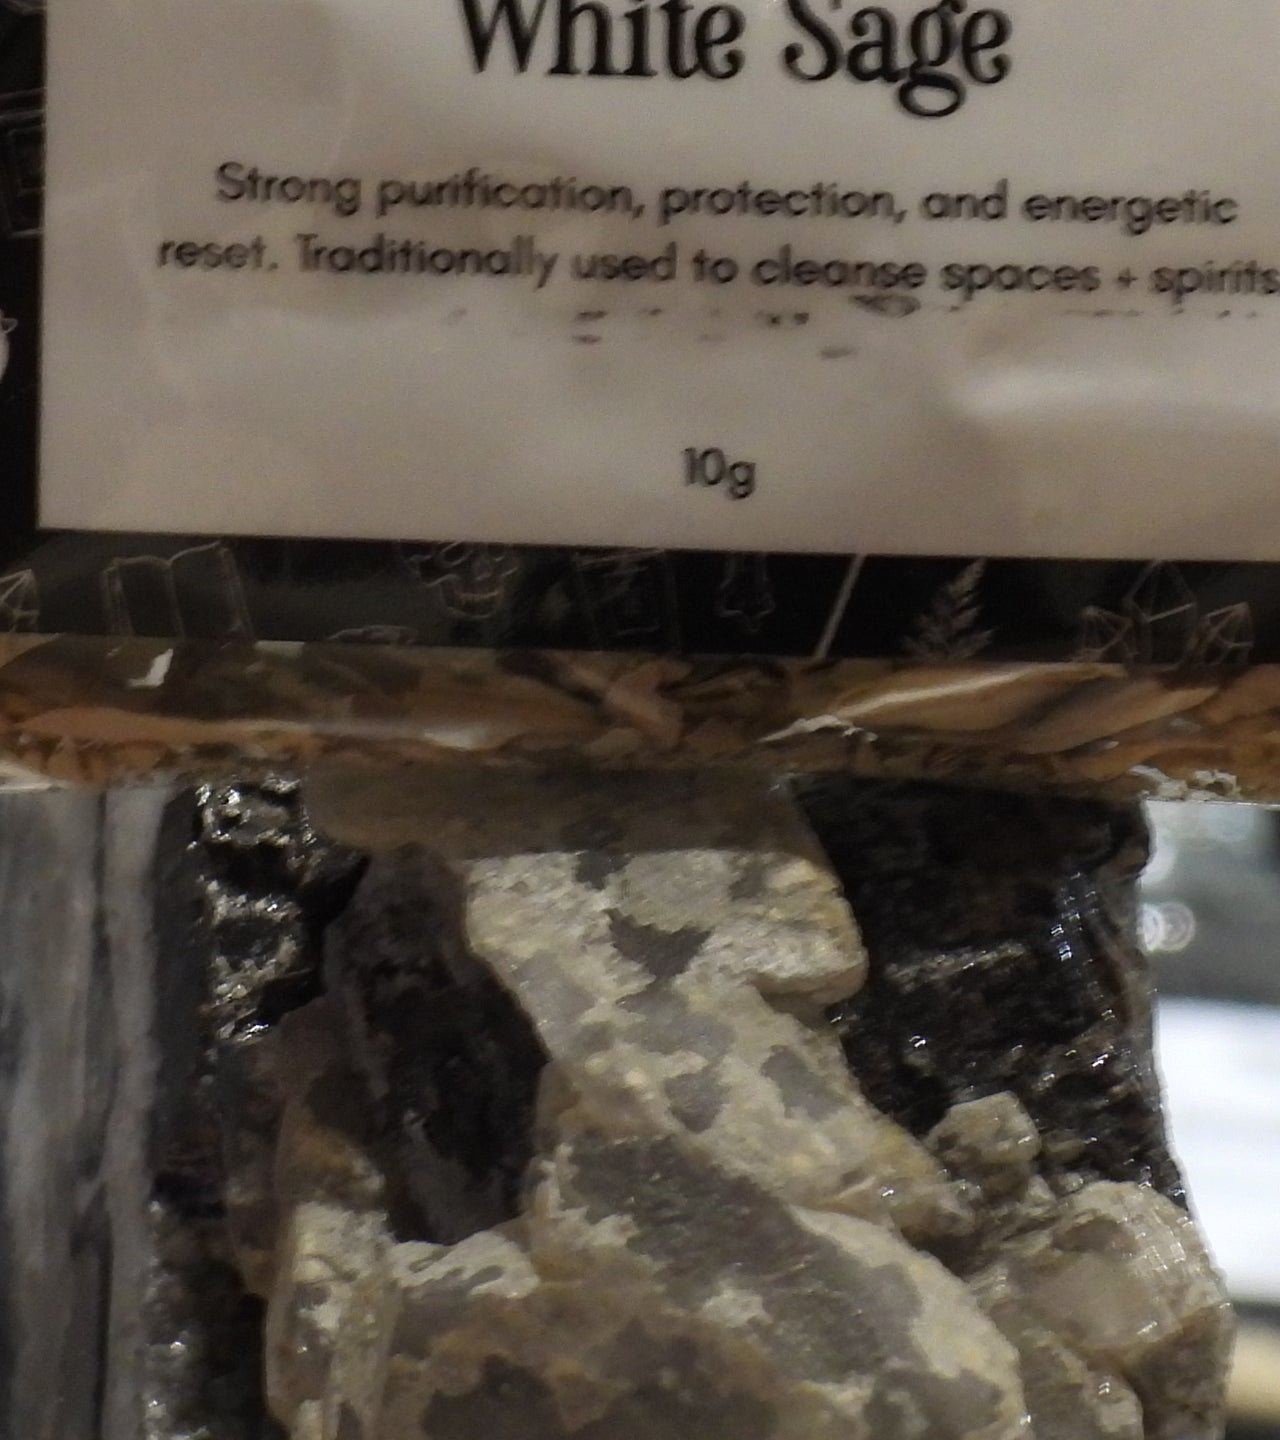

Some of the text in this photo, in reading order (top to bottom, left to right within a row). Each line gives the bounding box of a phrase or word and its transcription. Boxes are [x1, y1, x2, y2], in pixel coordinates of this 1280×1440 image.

[215, 160, 1240, 236] Strong purification, protection, and energetic
[156, 233, 280, 273] reset.
[293, 231, 560, 289] Traditionally
[570, 241, 678, 283] used
[691, 252, 738, 285] to
[750, 243, 928, 290] cleanse
[939, 259, 1102, 303] spaces
[1116, 266, 1138, 290] +
[682, 445, 757, 500] 10g
